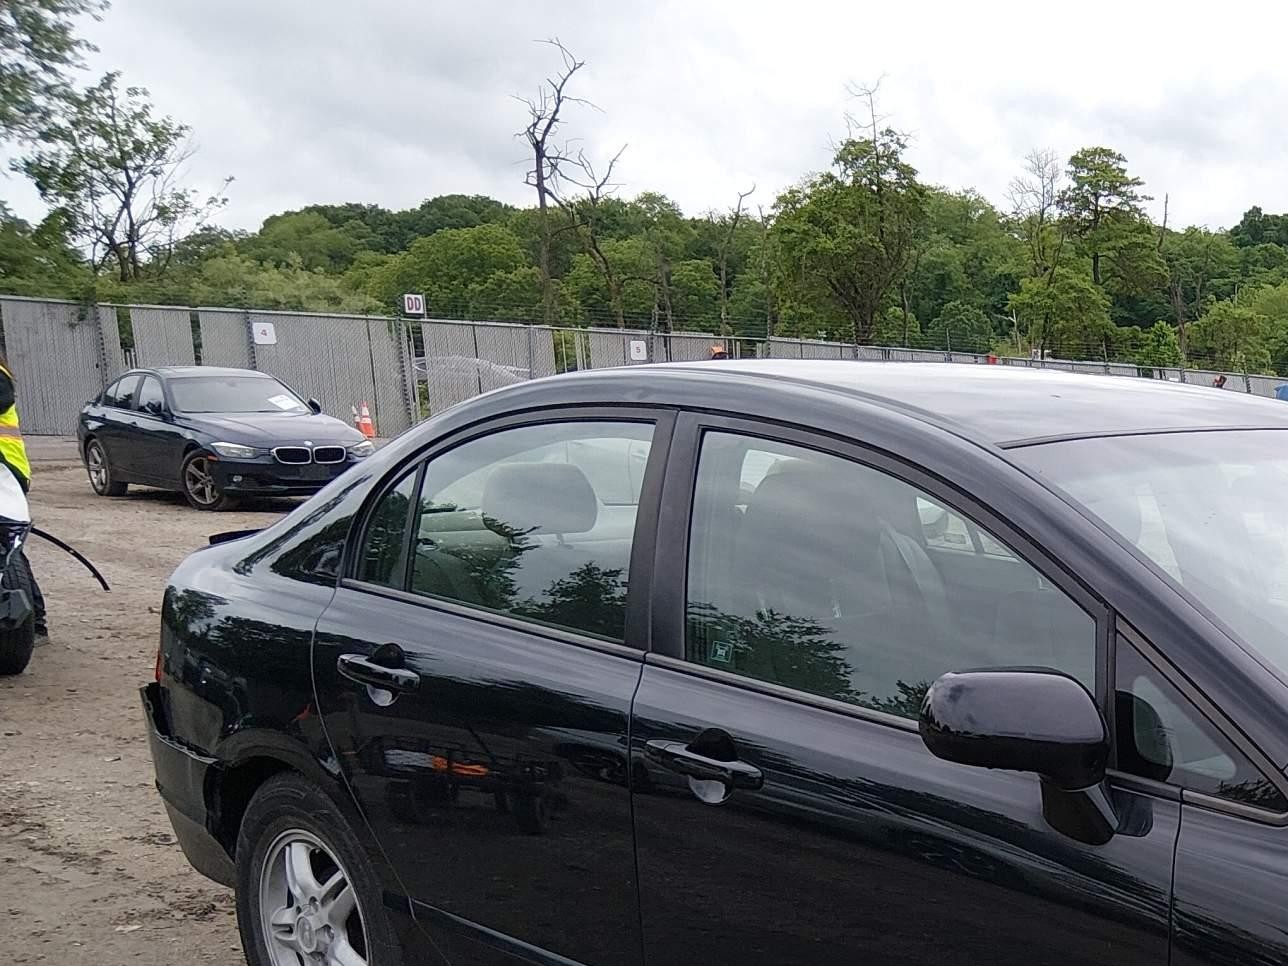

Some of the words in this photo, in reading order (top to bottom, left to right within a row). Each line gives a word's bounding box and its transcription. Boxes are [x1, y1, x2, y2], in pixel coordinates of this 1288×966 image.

[407, 296, 421, 311] DD
[260, 329, 267, 337] 4
[635, 346, 641, 354] 5
